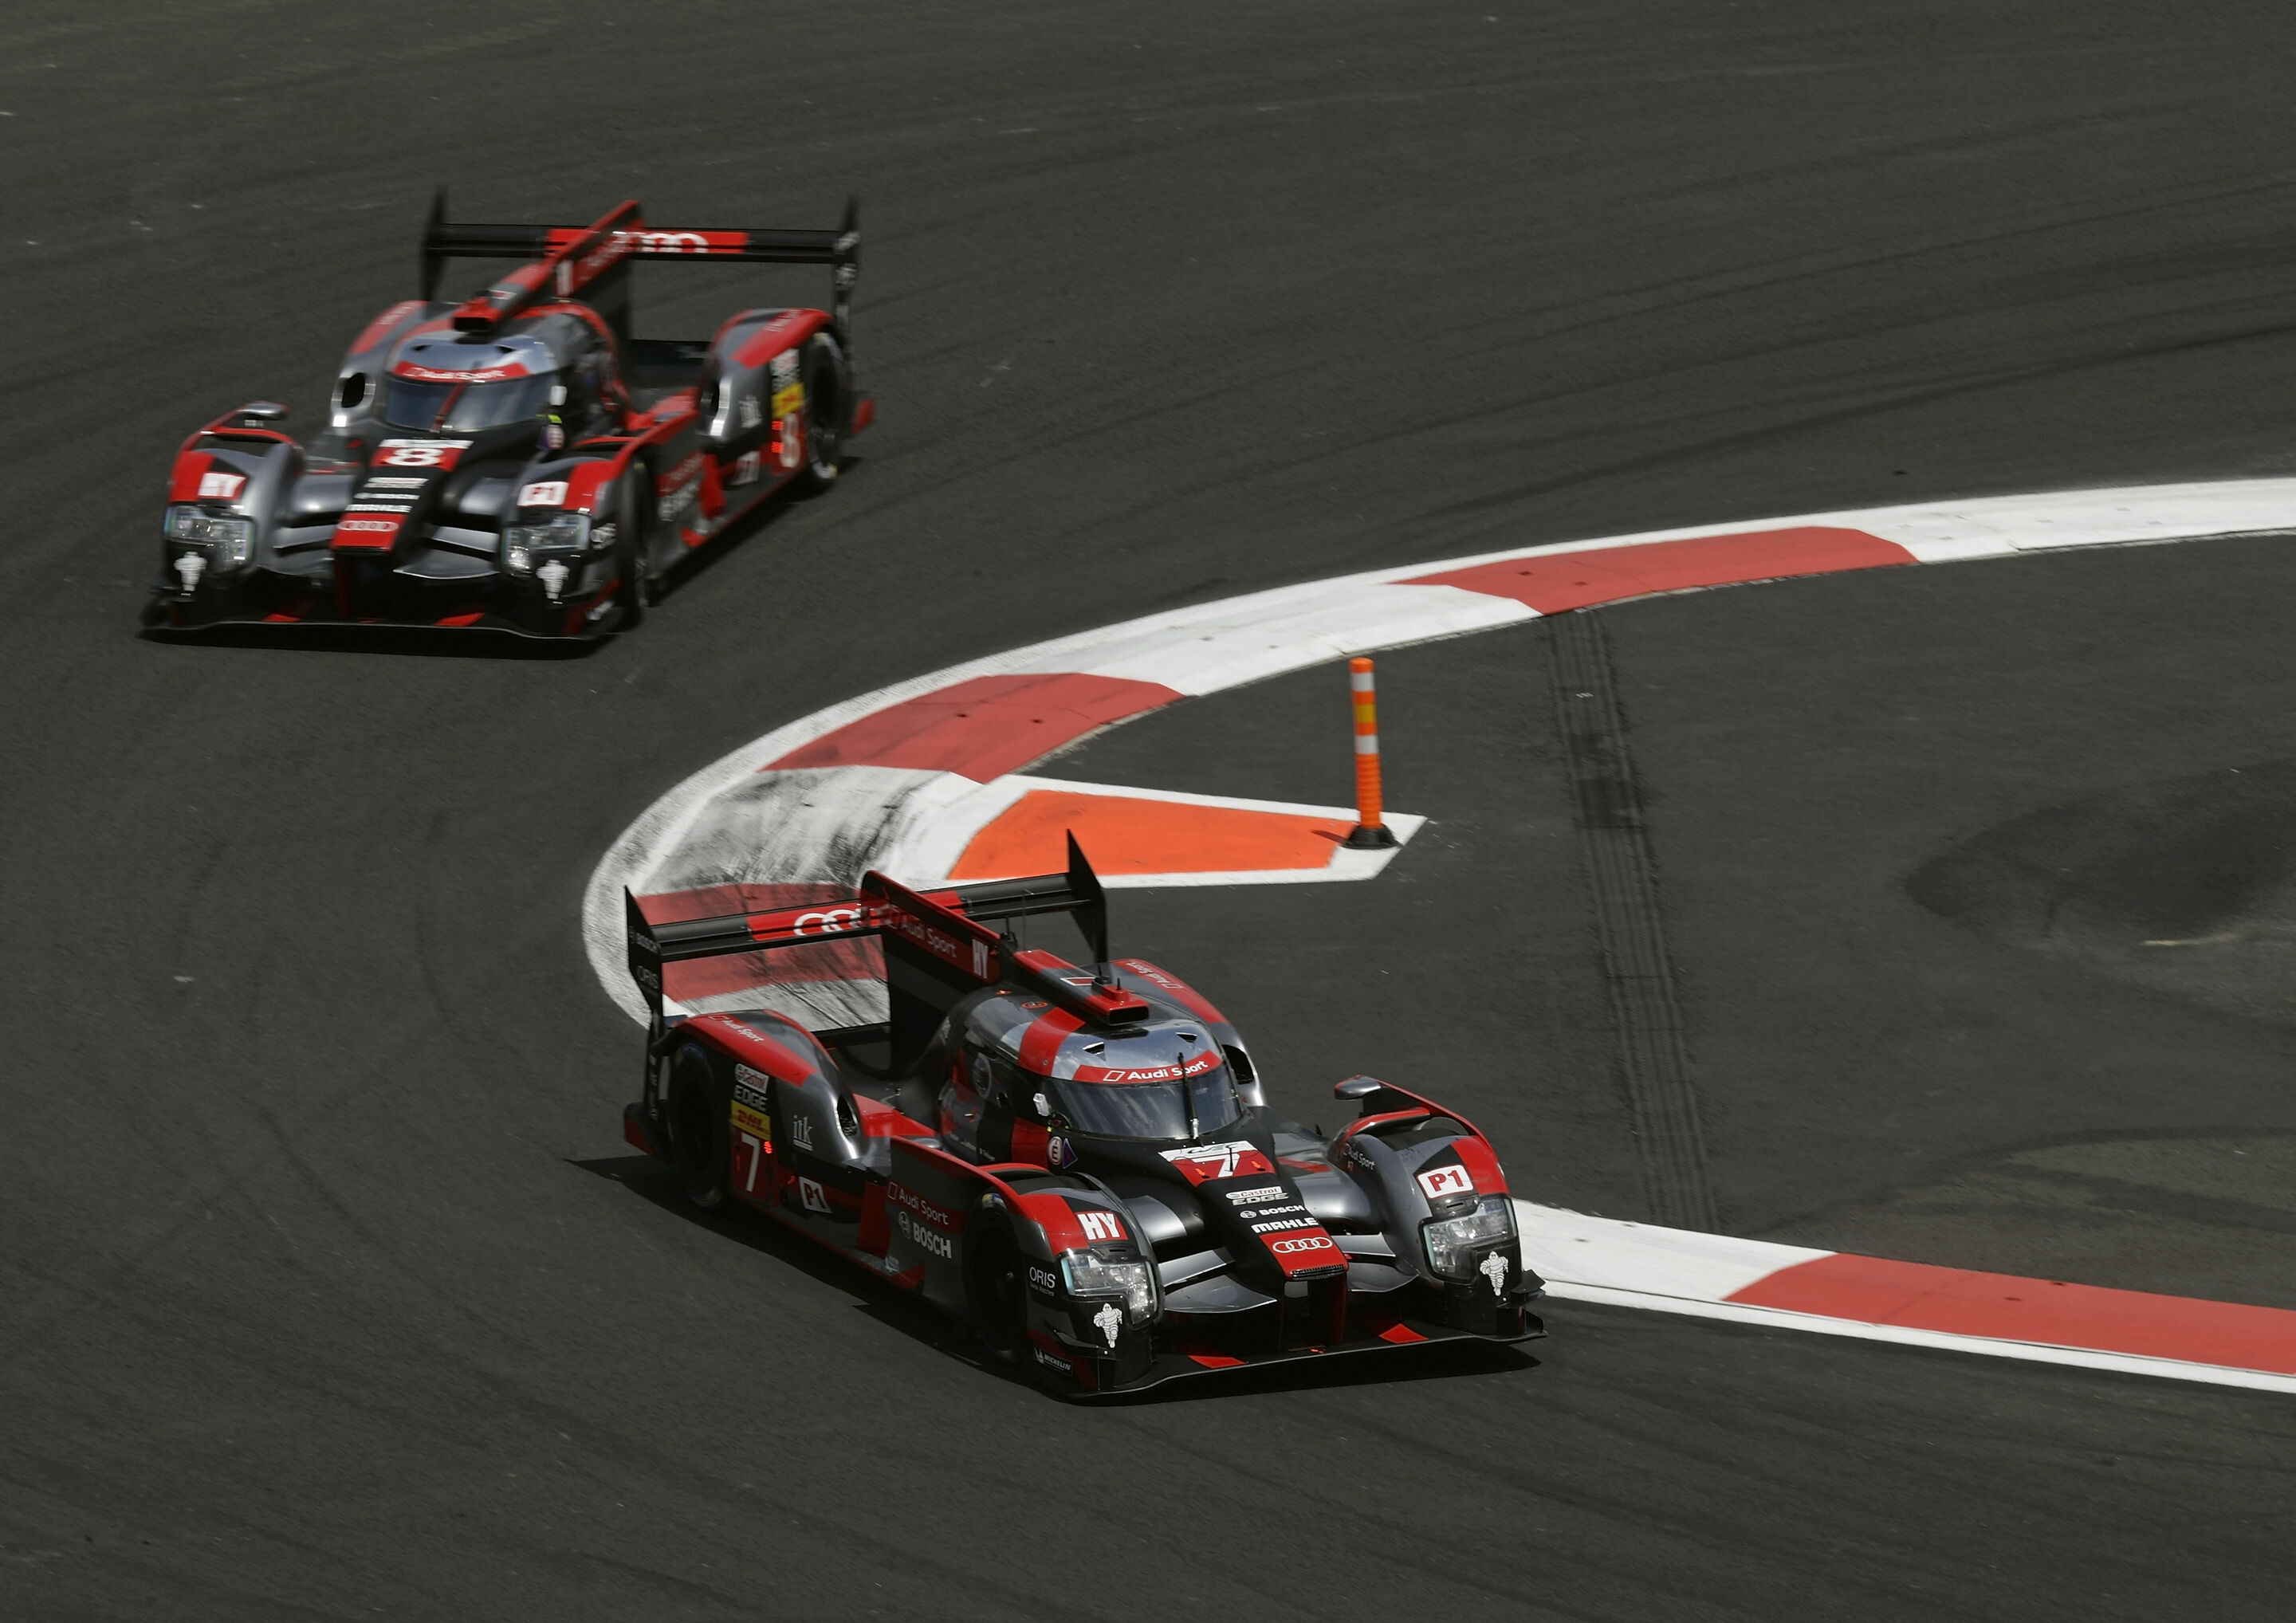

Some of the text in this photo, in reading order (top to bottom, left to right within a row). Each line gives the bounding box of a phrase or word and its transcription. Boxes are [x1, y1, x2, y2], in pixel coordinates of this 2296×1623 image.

[780, 411, 800, 469] 8
[383, 448, 444, 466] 8
[901, 916, 957, 958] Audi Sport
[972, 938, 989, 979] HY
[1127, 1068, 1170, 1080] Audi
[734, 1085, 768, 1112] EDGE
[793, 1114, 813, 1145] itk
[741, 1132, 761, 1193] 7
[1193, 1153, 1240, 1178] 7
[1358, 1153, 1375, 1170] Sport
[1427, 1169, 1464, 1193] P1
[804, 1182, 827, 1209] P1
[899, 1188, 949, 1225] Audi Sport
[1232, 1193, 1290, 1206] EDGE
[1259, 1204, 1306, 1216] BOSCH
[1077, 1212, 1121, 1240] HY
[1251, 1216, 1319, 1234] MAHLE
[913, 1222, 952, 1259] BOSCH
[1029, 1267, 1056, 1289] ORIS
[1044, 1353, 1071, 1371] MICHELIN
